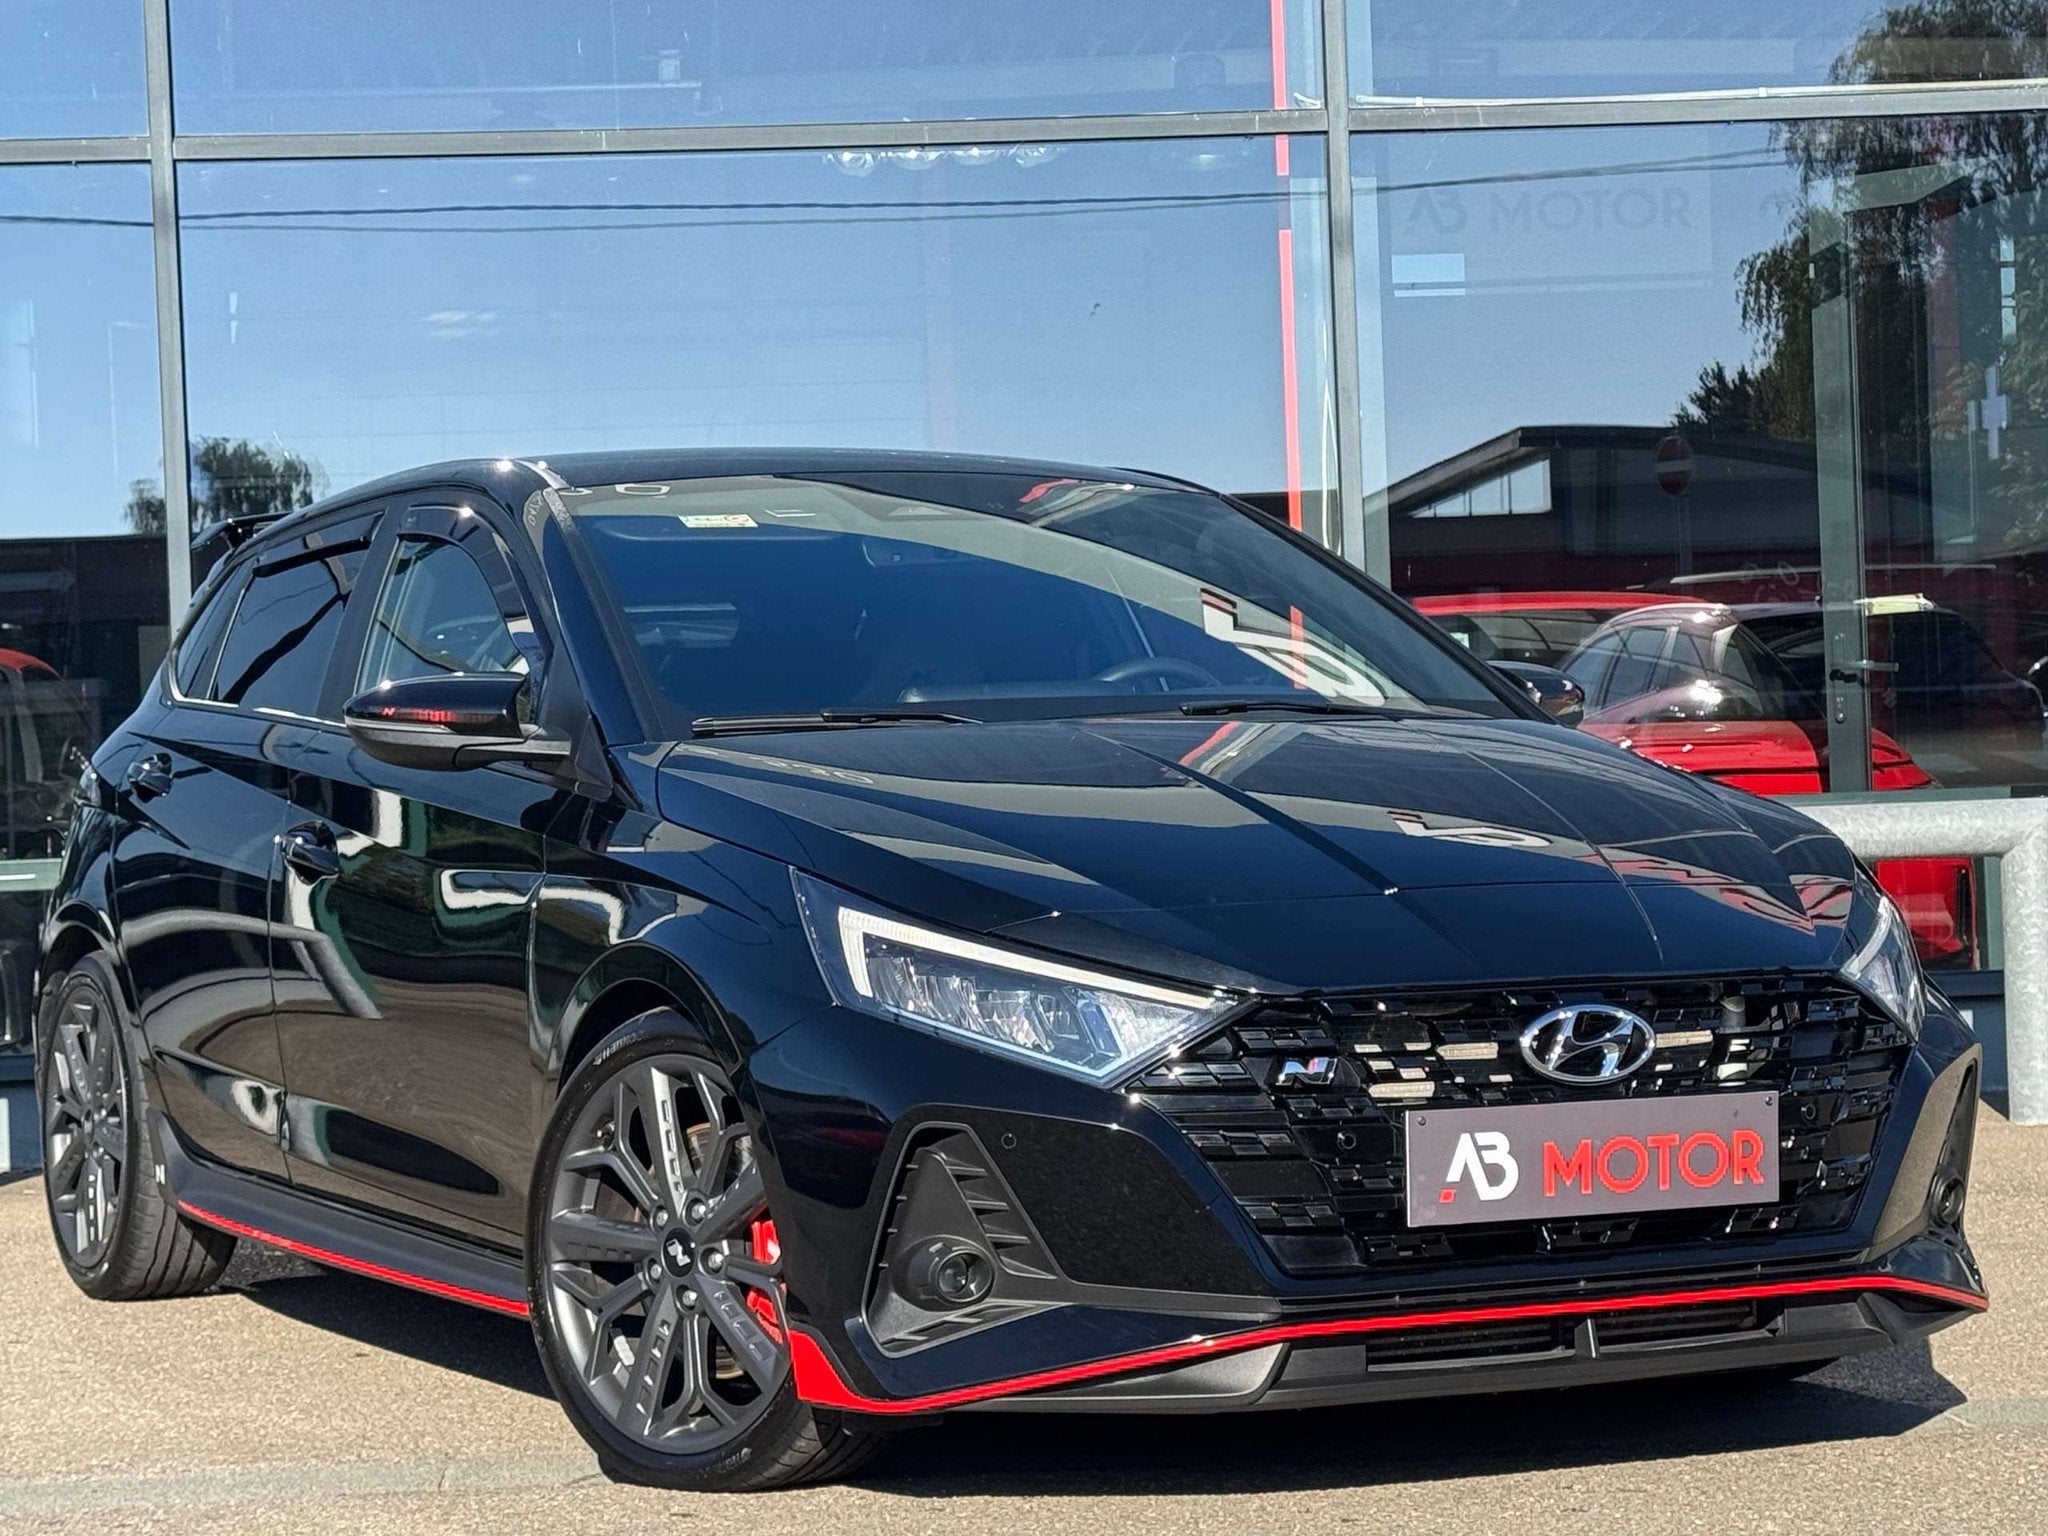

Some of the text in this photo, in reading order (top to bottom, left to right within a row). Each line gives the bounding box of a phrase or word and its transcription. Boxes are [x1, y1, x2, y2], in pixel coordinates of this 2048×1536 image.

[1408, 186, 1692, 235] AB MOTOR
[1444, 1128, 1765, 1201] AB MOTOR
